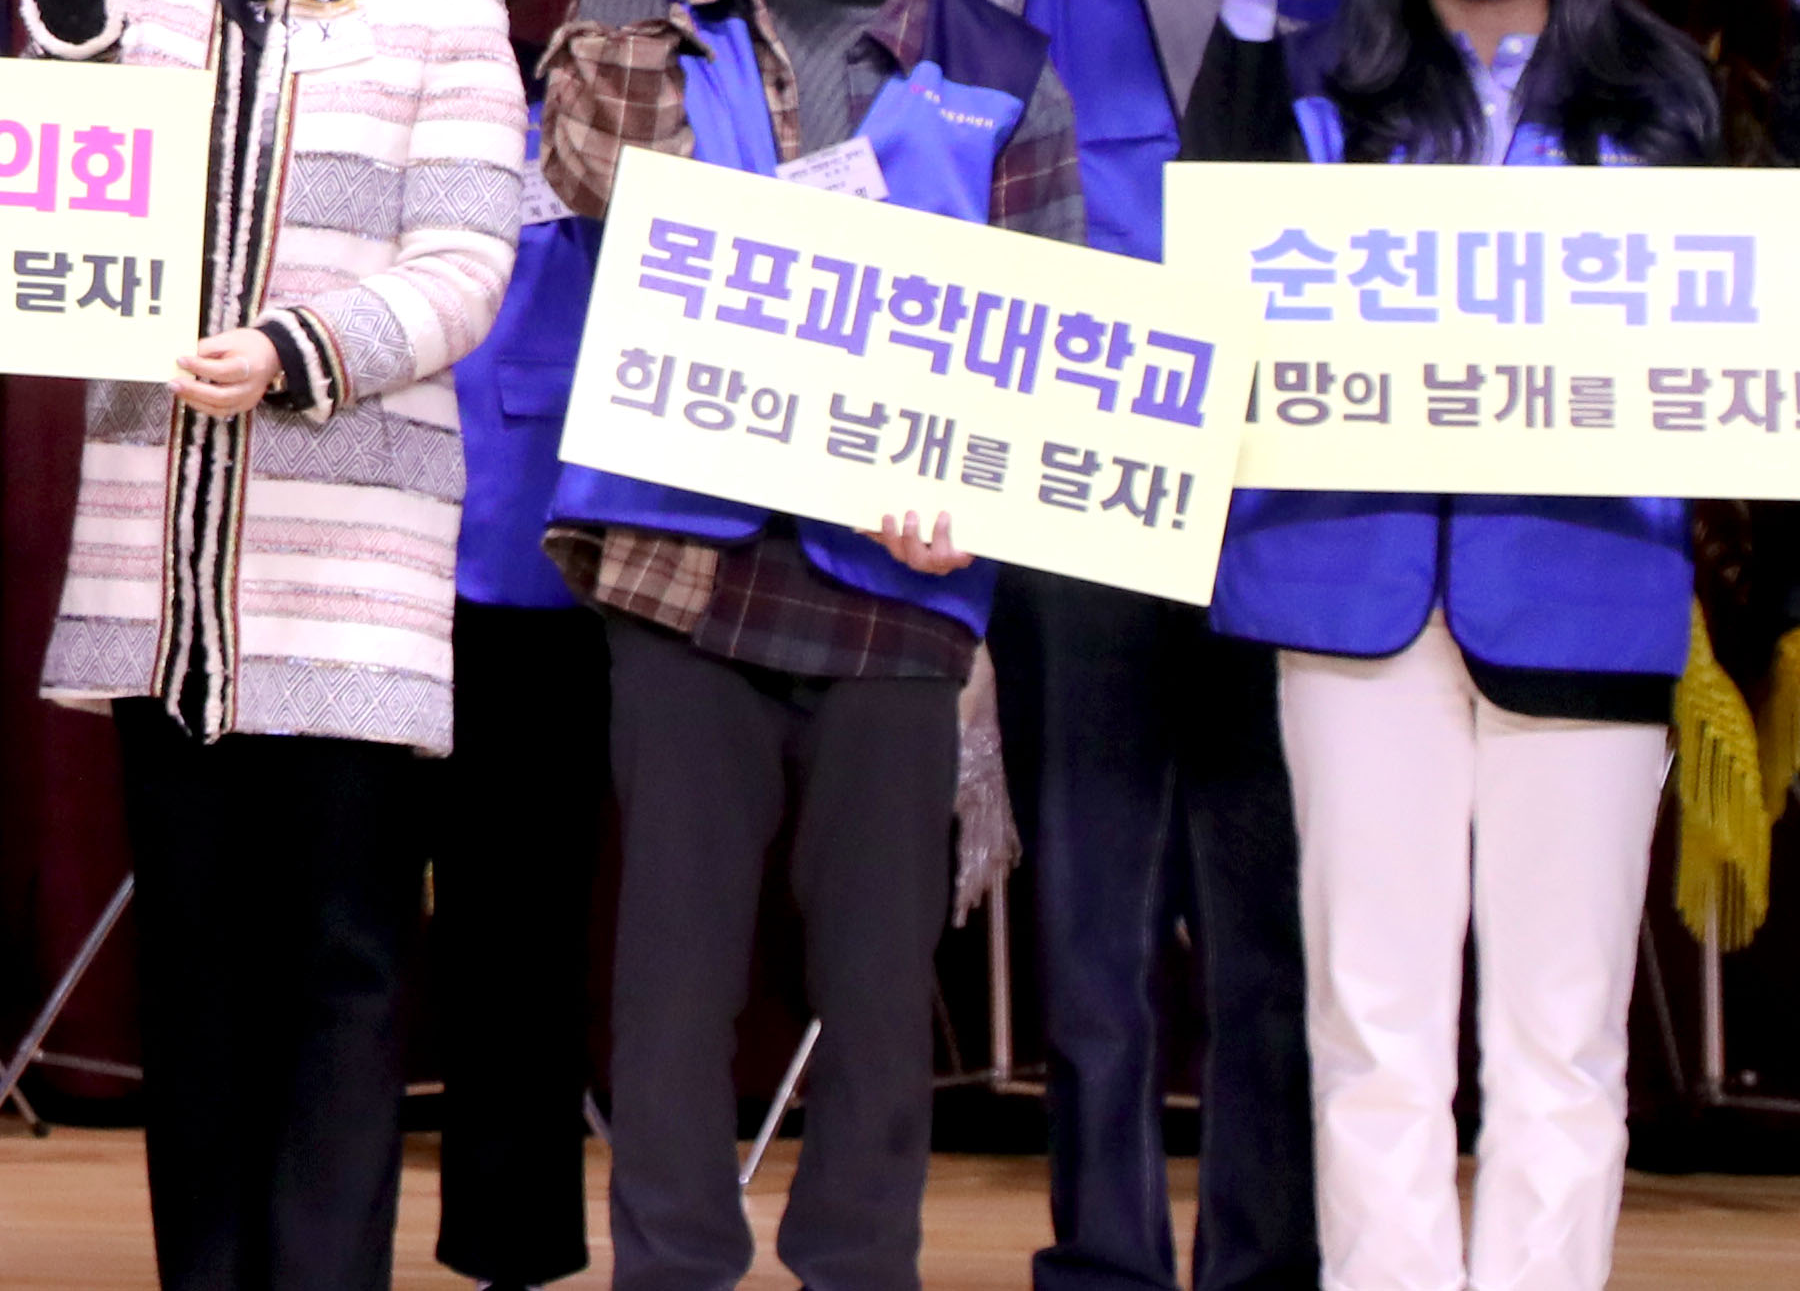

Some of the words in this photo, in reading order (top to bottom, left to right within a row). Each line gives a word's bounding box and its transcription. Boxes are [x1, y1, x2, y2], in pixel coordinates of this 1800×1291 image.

[13, 249, 166, 318] 달자!
[638, 216, 1216, 428] 목포과학대학교
[1250, 228, 1761, 326] 순천대학교
[610, 346, 800, 445] 희망의
[826, 392, 1012, 492] 날개를
[1037, 440, 1195, 531] 달자!
[1246, 359, 1392, 426] 망의
[1422, 362, 1617, 430] 날개를
